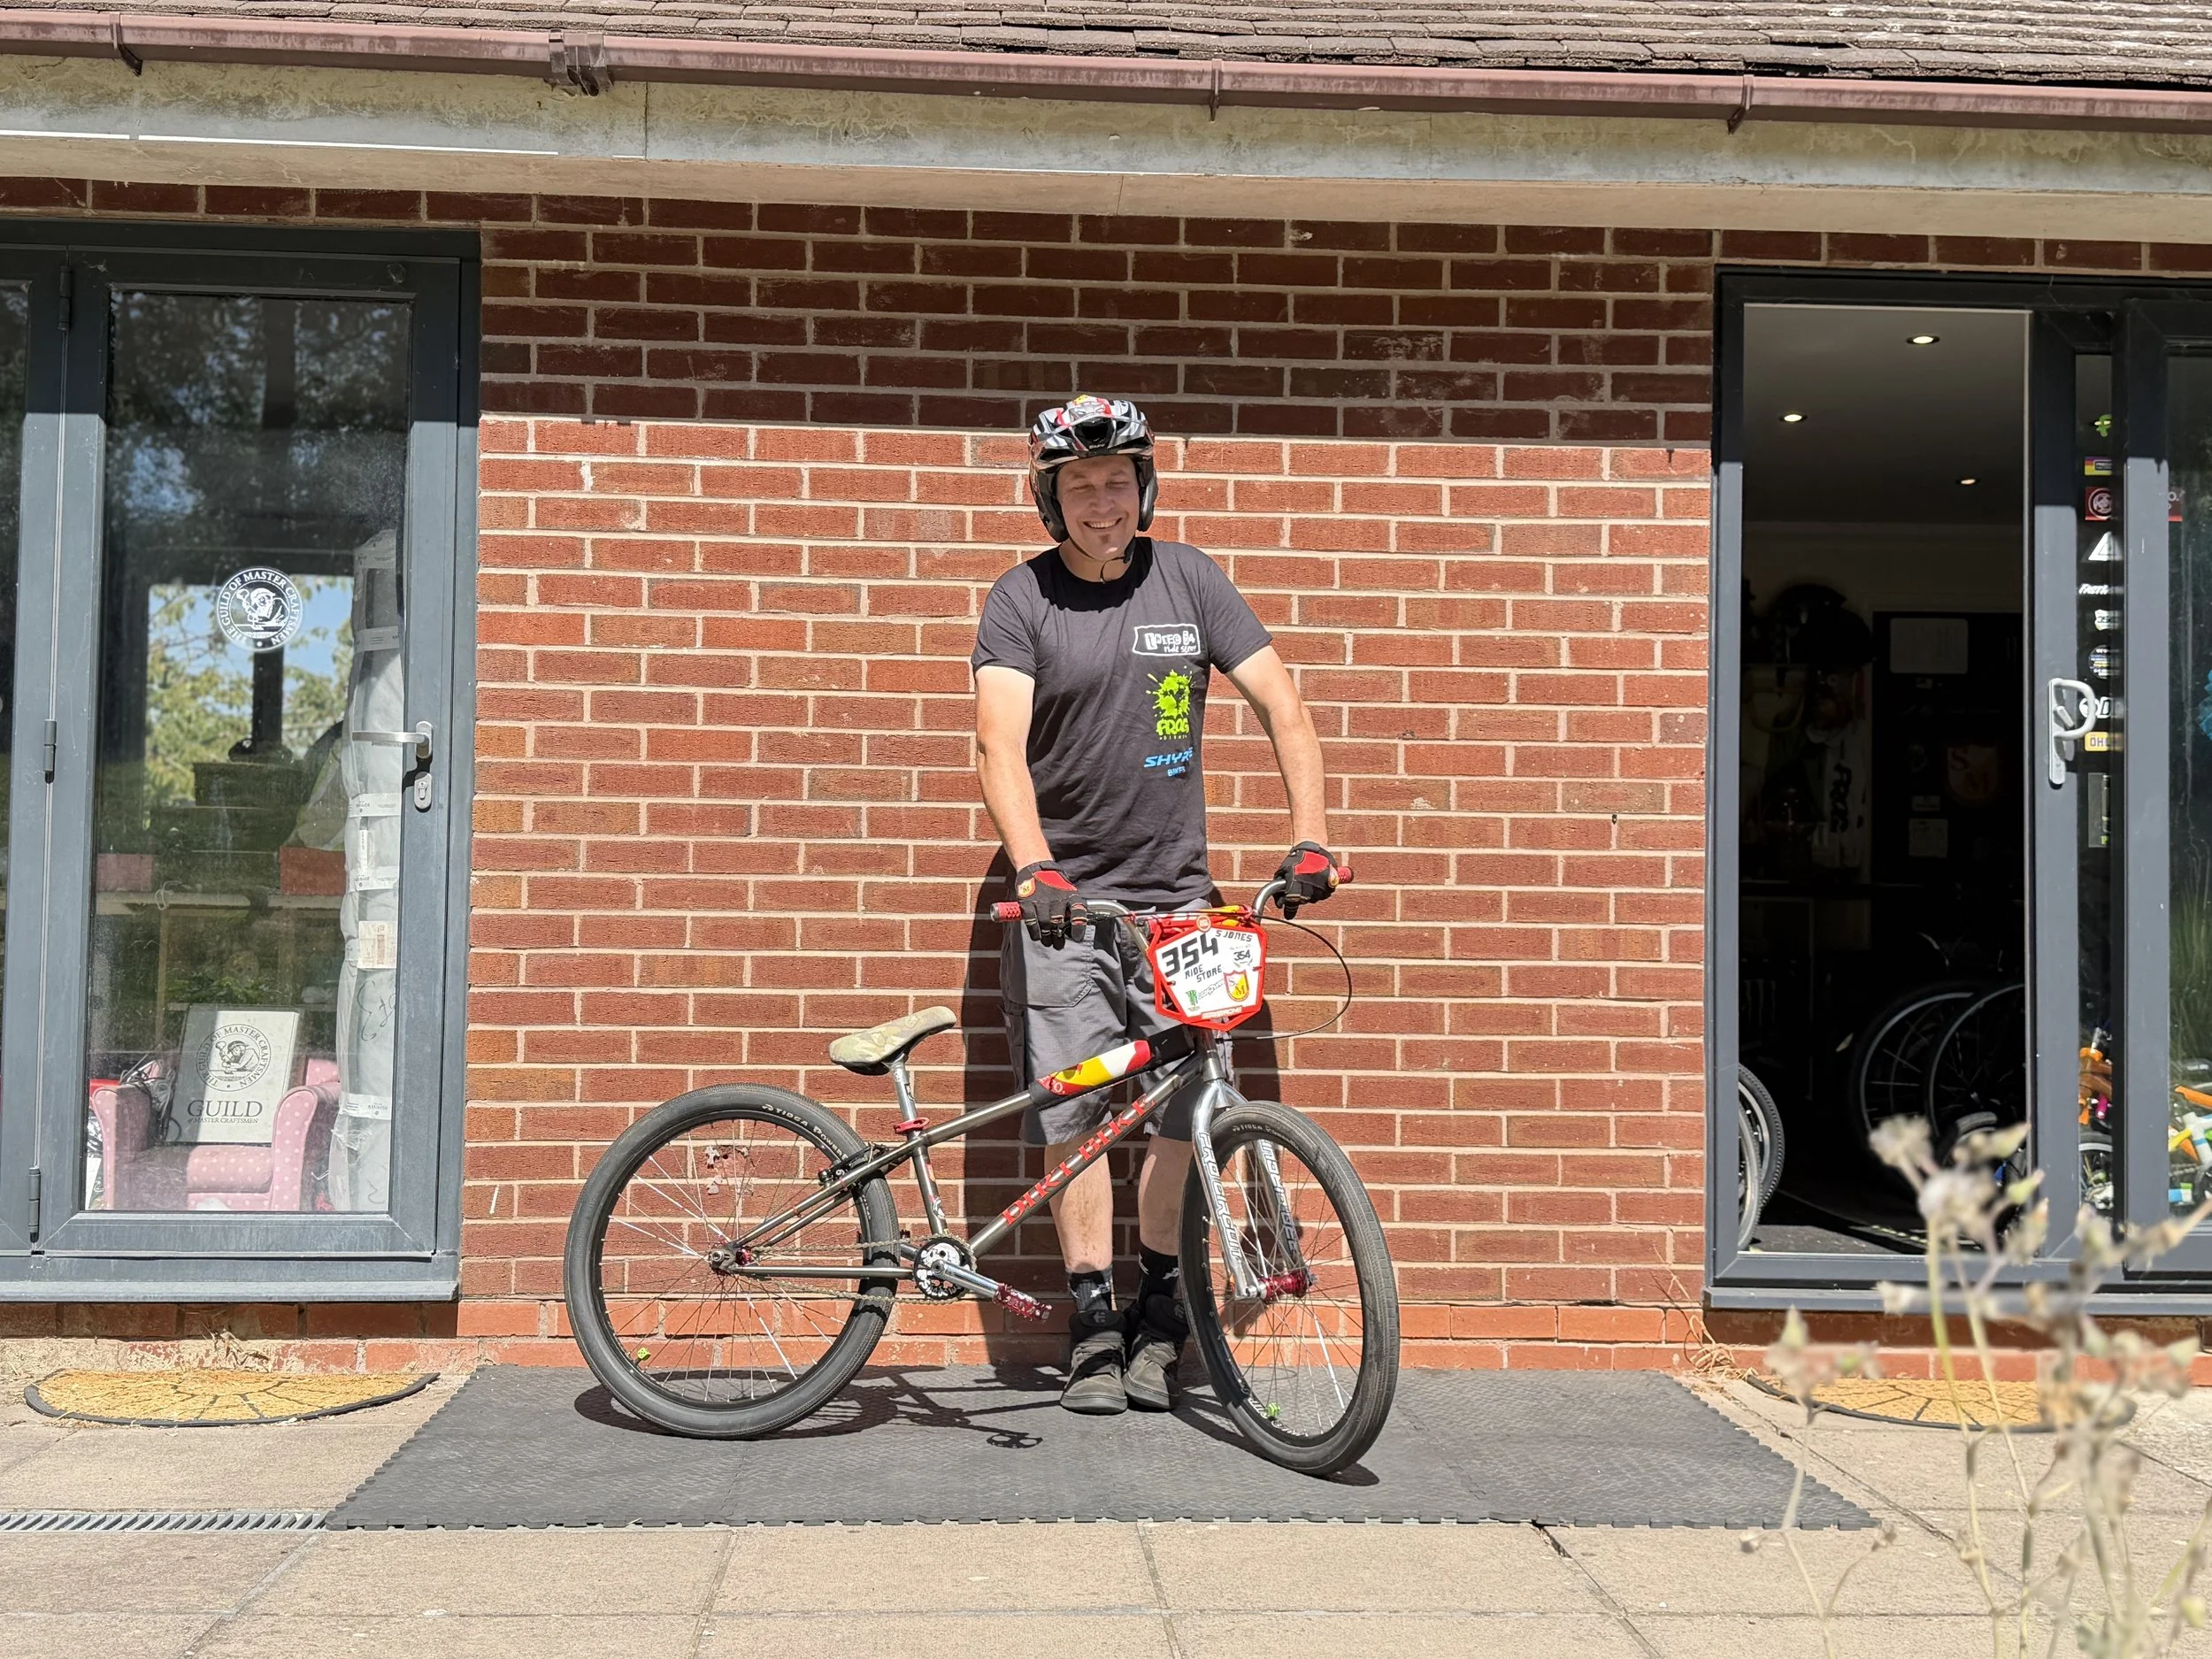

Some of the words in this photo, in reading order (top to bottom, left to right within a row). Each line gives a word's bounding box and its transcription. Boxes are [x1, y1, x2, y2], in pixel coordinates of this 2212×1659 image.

[228, 577, 242, 591] OF
[242, 571, 287, 588] MASTER
[219, 591, 231, 626] GUILD
[271, 587, 300, 645] CRAFTSMEN
[227, 626, 249, 644] THE
[1223, 931, 1254, 943] JONES
[1161, 933, 1219, 979] 354
[1184, 964, 1204, 979] RIDE
[1196, 964, 1223, 983] STORE
[210, 1032, 222, 1042] OF
[224, 1025, 260, 1041] MASTER
[198, 1042, 211, 1071] GUILD
[239, 1039, 269, 1088] CRAFTSMEN
[202, 1073, 219, 1088] THE
[187, 1099, 264, 1118] GUILD
[776, 1107, 809, 1127] TIOGA
[1002, 1154, 1074, 1226] DIRT
[1078, 1093, 1157, 1162] BIKE
[1198, 1132, 1221, 1178] PRO
[1210, 1180, 1242, 1261] CIRCUIT
